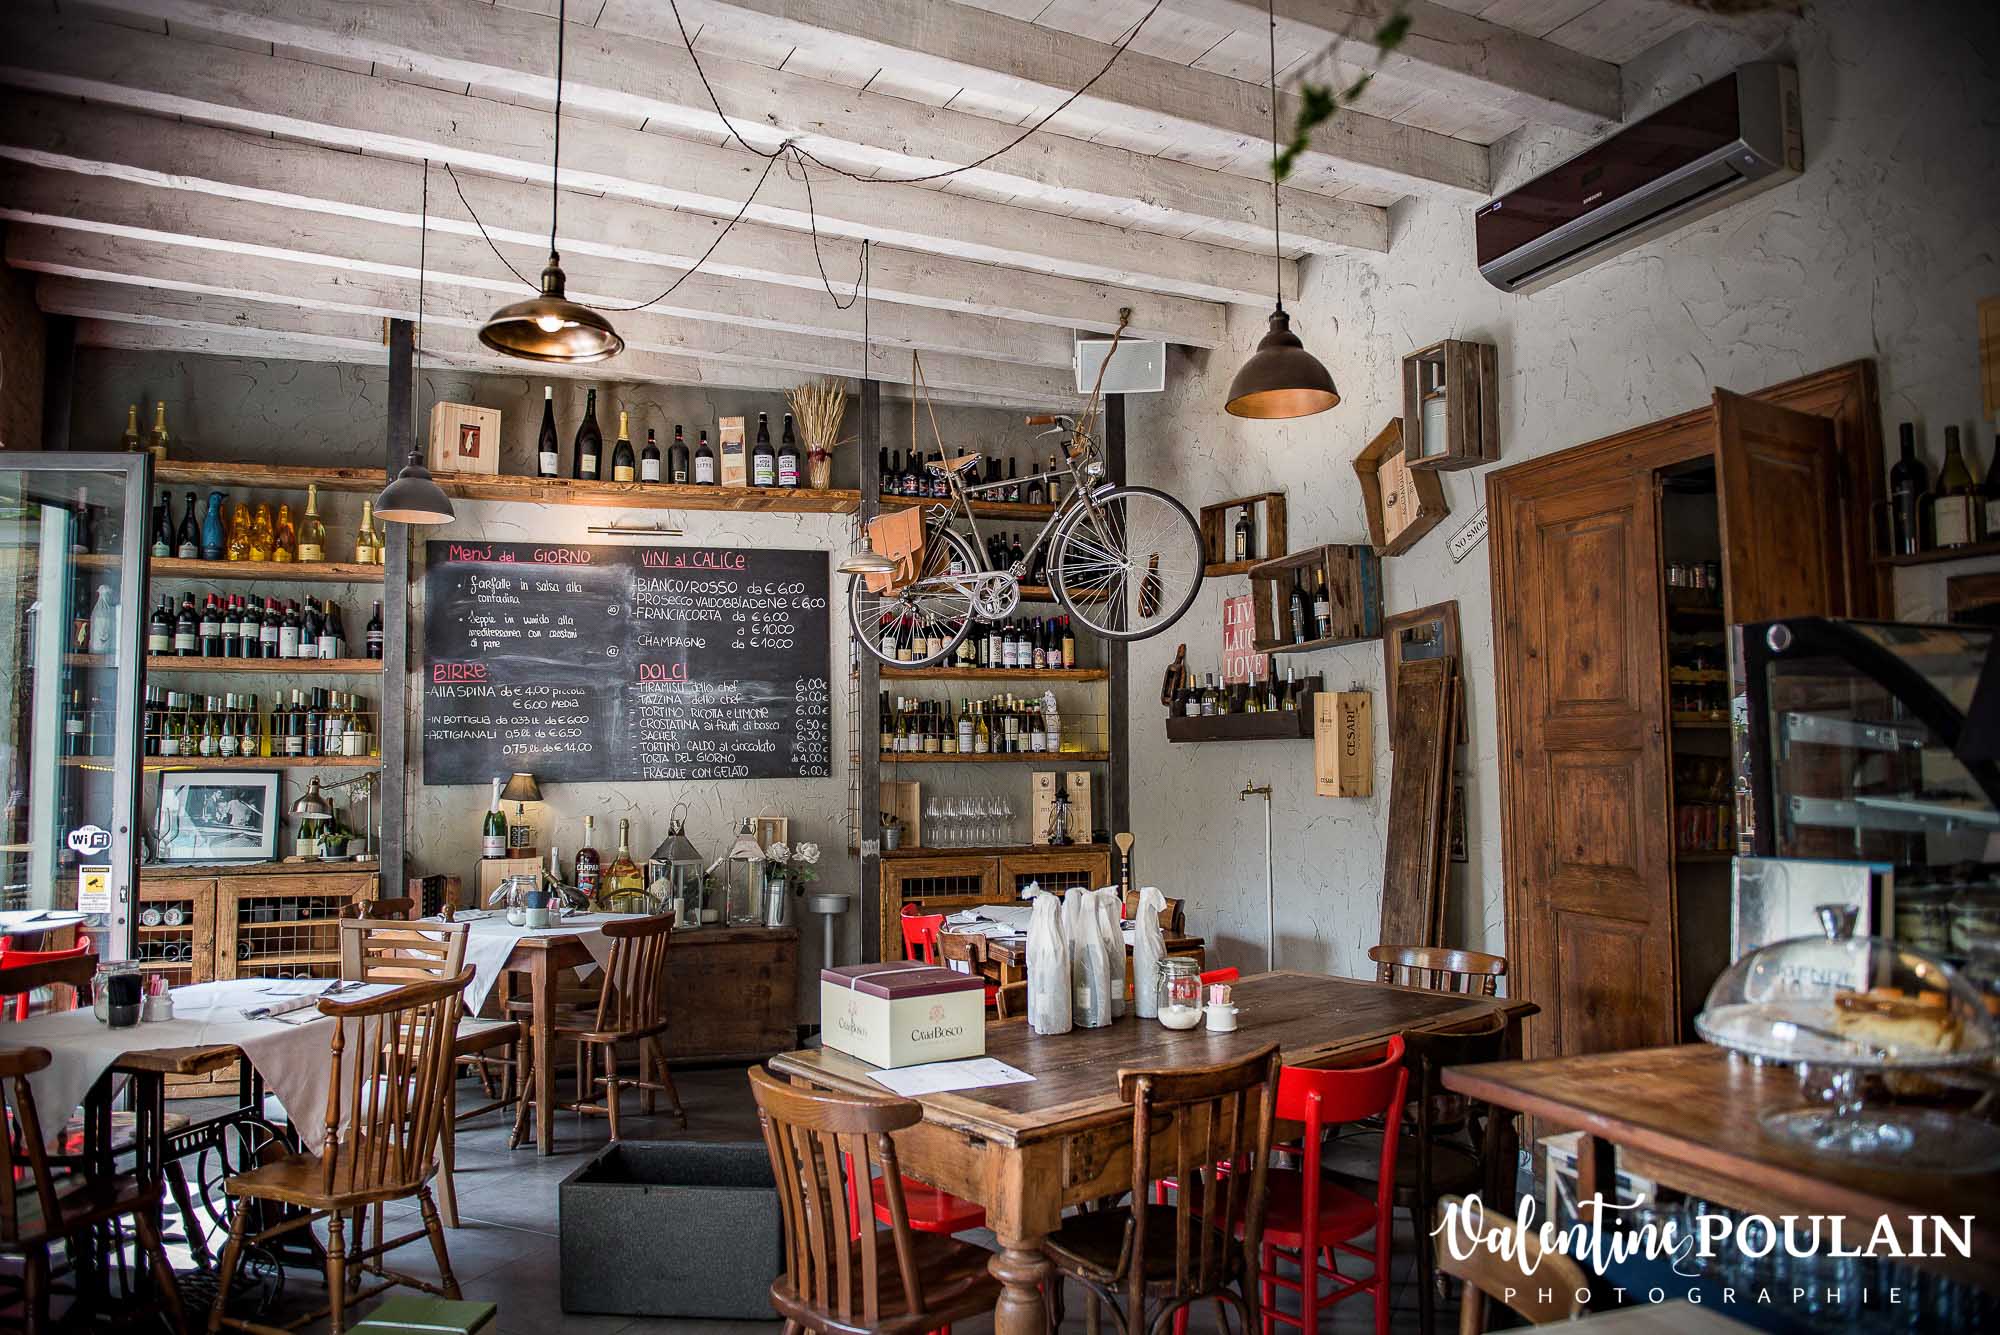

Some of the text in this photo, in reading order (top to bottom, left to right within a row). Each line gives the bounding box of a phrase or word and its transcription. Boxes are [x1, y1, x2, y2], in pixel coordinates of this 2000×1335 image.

[1455, 538, 1466, 551] NO
[450, 544, 591, 563] Menú del GIORNO
[642, 550, 668, 566] VINI
[675, 553, 685, 566] al
[520, 578, 528, 590] in
[536, 580, 559, 592] salsa
[566, 581, 582, 592] alla
[747, 581, 762, 594] da
[478, 593, 520, 603] contadina
[505, 613, 514, 623] in
[523, 614, 549, 624] umido
[558, 615, 574, 625] alla
[637, 607, 721, 621] FRANCIACORTA
[733, 611, 745, 621] da
[1227, 601, 1253, 625] LIV
[737, 627, 744, 635] a
[471, 638, 500, 651] di pane
[732, 640, 744, 648] da
[1225, 627, 1256, 651] LAUG
[640, 663, 687, 679] DOLCI
[1227, 654, 1264, 678] LOVE
[457, 686, 496, 697] SPINA
[501, 686, 512, 696] da
[692, 682, 713, 692] dello
[718, 680, 738, 692] chef
[639, 694, 682, 704] TAZZINA
[692, 695, 715, 704] dello
[720, 693, 741, 704] chef
[639, 706, 684, 717] TORTINO
[691, 708, 723, 719] RICOTTA
[727, 710, 732, 718] e
[432, 716, 440, 724] IN
[496, 716, 508, 724] da
[545, 716, 557, 724] da
[640, 718, 700, 730] CROSTATINA
[704, 720, 713, 731] ai
[743, 721, 751, 730] di
[754, 720, 779, 730] bosco
[535, 730, 545, 738] da
[641, 730, 677, 740] SACHER
[1347, 711, 1355, 756] CESARI
[543, 744, 553, 752] da
[640, 742, 680, 752] TORTINO
[687, 741, 715, 751] CALDO
[720, 742, 728, 751] al
[731, 740, 775, 752] cioccolato
[640, 754, 669, 763] TORTA
[675, 753, 692, 763] DEL
[697, 752, 735, 763] GIORNO
[792, 754, 799, 762] da
[644, 767, 686, 779] FRAGOLE
[692, 768, 711, 778] CON
[714, 766, 748, 777] GELATO
